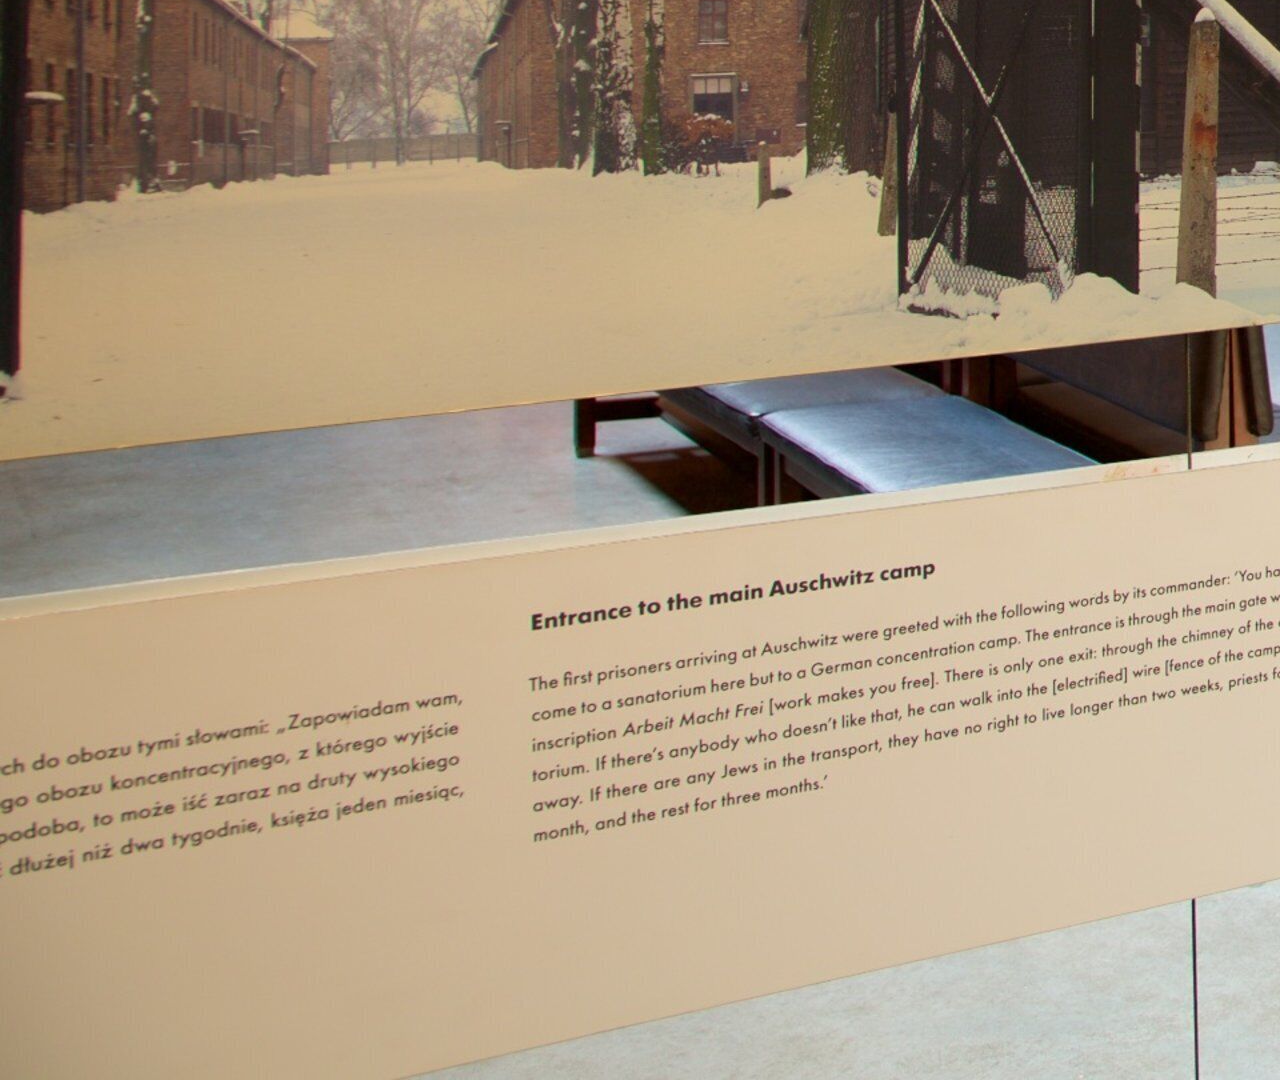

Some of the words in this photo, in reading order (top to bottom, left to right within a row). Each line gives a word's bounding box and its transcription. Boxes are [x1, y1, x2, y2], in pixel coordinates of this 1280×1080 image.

[528, 676, 558, 691] The
[564, 671, 592, 686] first
[597, 662, 672, 685] prisoners
[676, 650, 737, 669] arriving
[742, 646, 757, 659] at
[761, 634, 838, 656] Auschwitz
[842, 630, 878, 642] were
[883, 616, 939, 640] greeted
[943, 612, 972, 627] with
[976, 609, 997, 623] the
[1001, 600, 1064, 619] following
[1069, 591, 1110, 608] words
[1113, 589, 1130, 604] by
[1133, 587, 1146, 598] its
[1150, 574, 1230, 596] commander:
[532, 606, 632, 631] Entrance
[638, 601, 661, 616] to
[666, 593, 703, 611] the
[709, 584, 763, 606] main
[769, 570, 874, 597] Auschwitz
[880, 564, 935, 581] camp
[532, 706, 576, 722] come
[581, 702, 597, 714] to
[602, 700, 612, 710] a
[617, 685, 706, 708] sanatorium
[711, 678, 745, 693] here
[750, 672, 774, 686] but
[778, 670, 792, 682] to
[797, 670, 806, 679] a
[811, 659, 872, 676] German
[876, 642, 975, 666] concentration
[979, 636, 1021, 650] camp.
[1025, 628, 1049, 642] The
[1053, 621, 1112, 638] entrance
[1116, 616, 1124, 628] is
[1128, 606, 1178, 626] through
[1182, 604, 1202, 617] the
[1205, 599, 1235, 614] main
[1239, 596, 1267, 612] gate
[0, 796, 28, 814] go
[36, 784, 102, 803] obozu
[110, 753, 290, 791] koncentracyjnego,
[298, 749, 309, 760] z
[316, 737, 387, 756] którego
[394, 722, 458, 746] wyjście
[32, 754, 60, 770] do
[66, 746, 131, 765] obozu
[138, 733, 180, 756] tymi
[186, 720, 269, 746] słowami:
[416, 694, 462, 709] wam,
[10, 850, 74, 875] dłużej
[82, 843, 112, 862] niż
[120, 838, 164, 855] dwa
[172, 819, 262, 848] tygodnie,
[271, 807, 329, 828] księża
[336, 797, 386, 820] jeden
[394, 786, 464, 806] miesiąc,
[93, 814, 114, 827] to
[121, 802, 175, 822] może
[183, 794, 207, 811] iść
[214, 787, 270, 806] zaraz
[278, 782, 301, 795] na
[308, 772, 357, 790] druty
[363, 756, 460, 782] wysokiego
[534, 820, 589, 842] month,
[595, 811, 626, 830] and
[632, 808, 656, 824] the
[662, 802, 690, 818] rest
[694, 797, 717, 812] for
[721, 792, 760, 807] three
